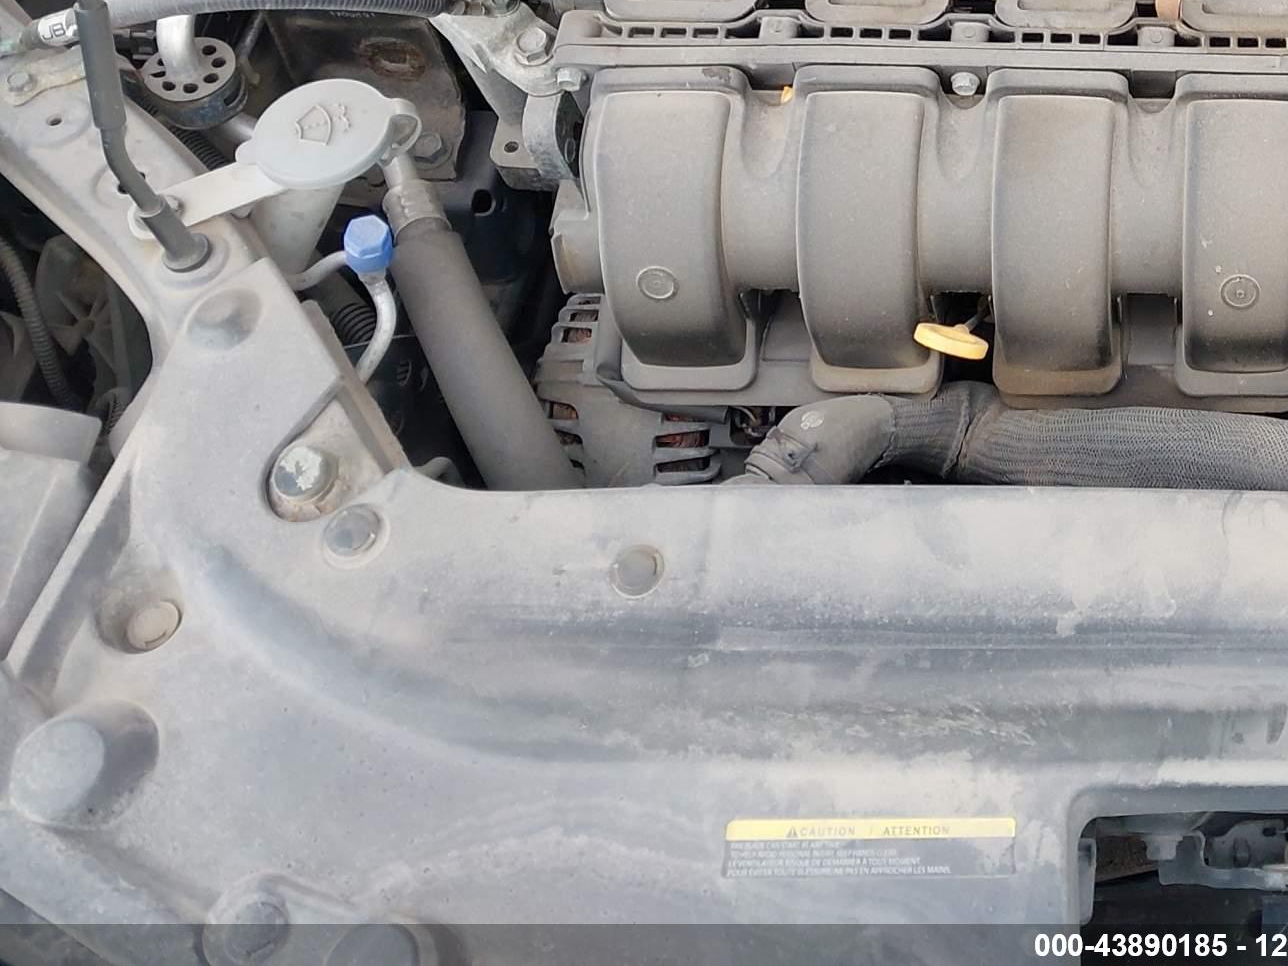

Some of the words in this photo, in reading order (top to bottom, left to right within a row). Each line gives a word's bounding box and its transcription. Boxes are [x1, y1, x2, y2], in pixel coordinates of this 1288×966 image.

[41, 23, 66, 40] JB
[800, 825, 855, 837] CAUTION
[882, 825, 950, 836] ATTENTION
